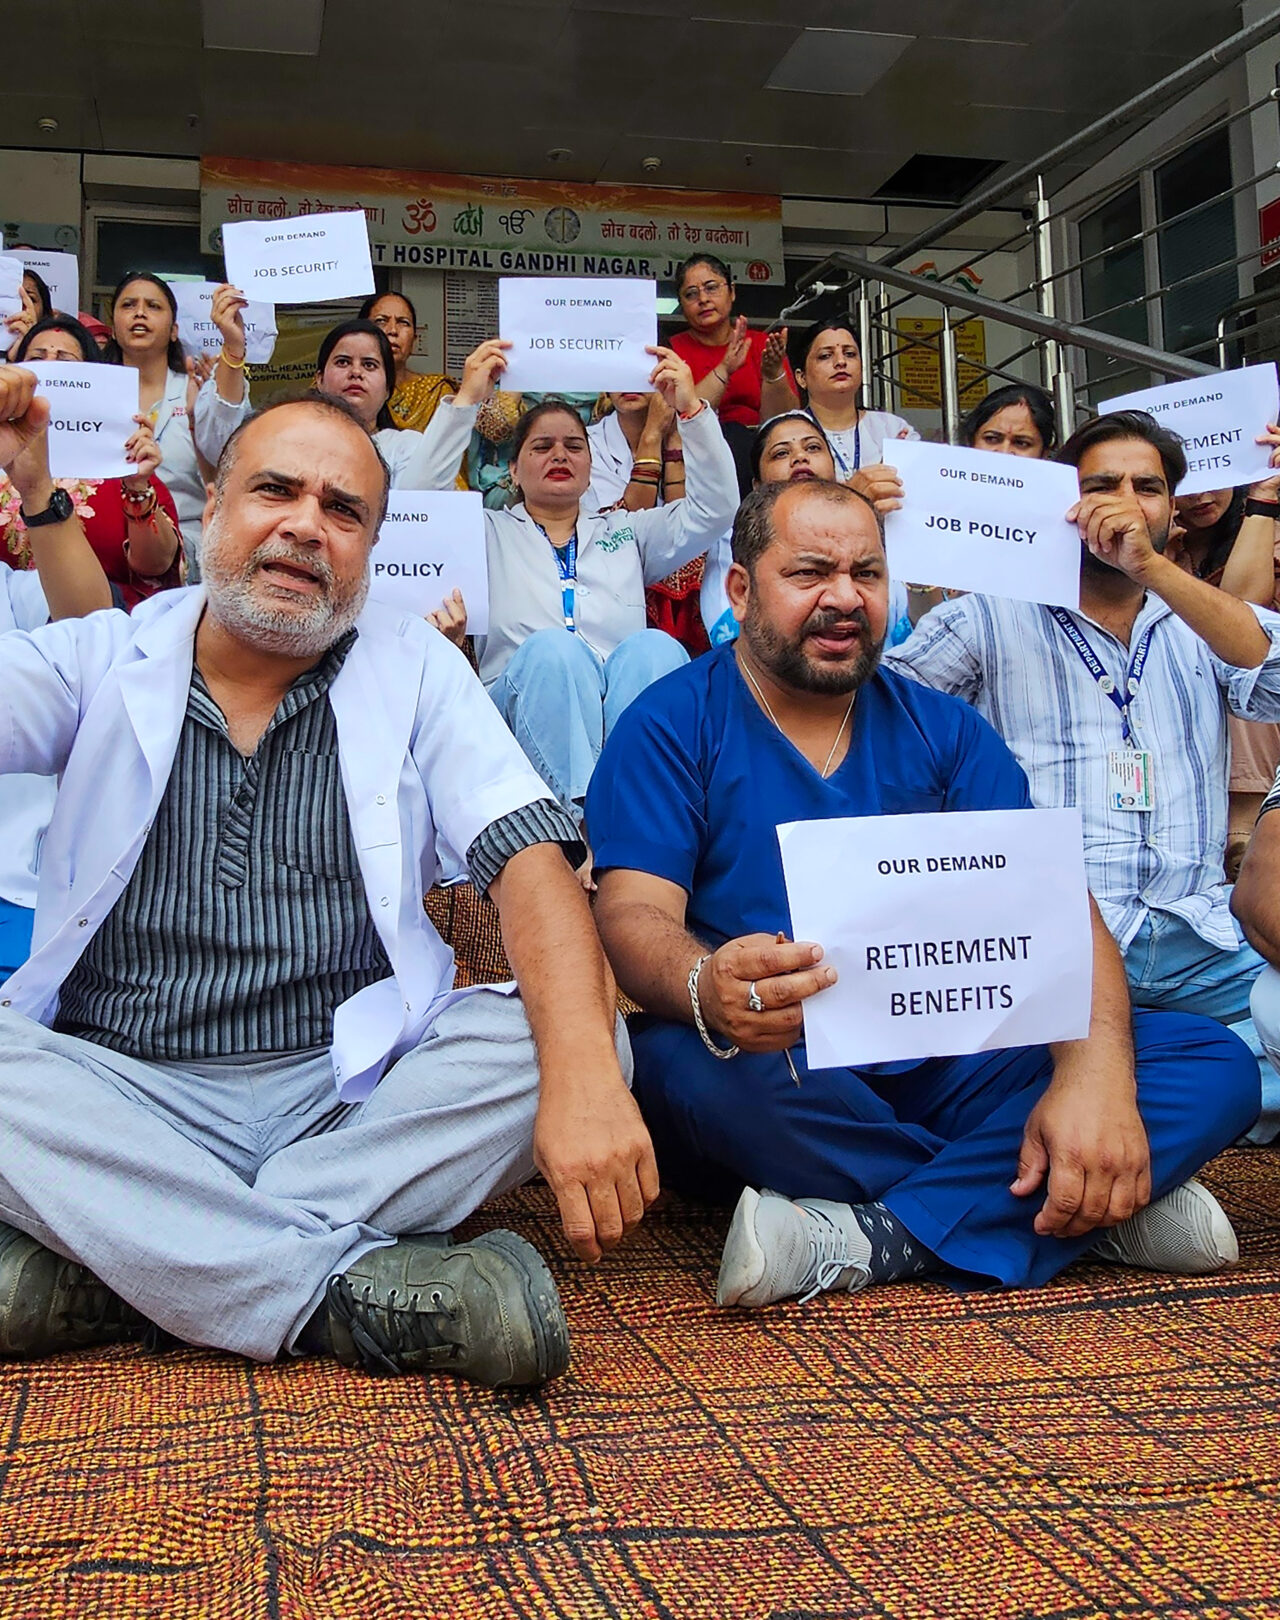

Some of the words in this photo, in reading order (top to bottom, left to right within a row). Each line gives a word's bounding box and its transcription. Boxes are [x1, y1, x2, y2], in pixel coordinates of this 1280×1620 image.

[227, 194, 254, 214] सोच
[264, 235, 284, 243] OUR
[287, 231, 326, 240] DEMAND
[601, 219, 626, 239] सोच
[667, 222, 681, 241] तो
[684, 222, 702, 243] देश
[394, 245, 493, 268] HOSPITAL
[500, 251, 576, 273] GANDHI
[584, 256, 657, 280] NAGAR,
[254, 268, 278, 278] JOB
[545, 298, 567, 306] OUR
[570, 299, 612, 307] DEMAND
[529, 338, 555, 349] JOB
[559, 338, 624, 350] SECURITY
[279, 363, 317, 372] HEALTH
[45, 380, 91, 389] DEMAND
[1146, 403, 1170, 414] OUR
[1173, 392, 1224, 409] DEMAND
[1184, 428, 1242, 451] EMENT
[1189, 455, 1231, 472] EFITS
[940, 468, 967, 480] OUR
[971, 472, 1024, 488] DEMAND
[384, 513, 429, 522] EMAND
[925, 516, 962, 532] JOB
[969, 521, 1037, 544] POLICY
[375, 563, 444, 577] POLICY
[1056, 611, 1068, 623] OF
[1063, 621, 1101, 675] DEPARTMENT
[877, 859, 922, 875] OUR
[926, 854, 1007, 873] DEMAND
[866, 935, 1032, 971] RETIREMENT
[890, 984, 1013, 1017] BENEFITS
